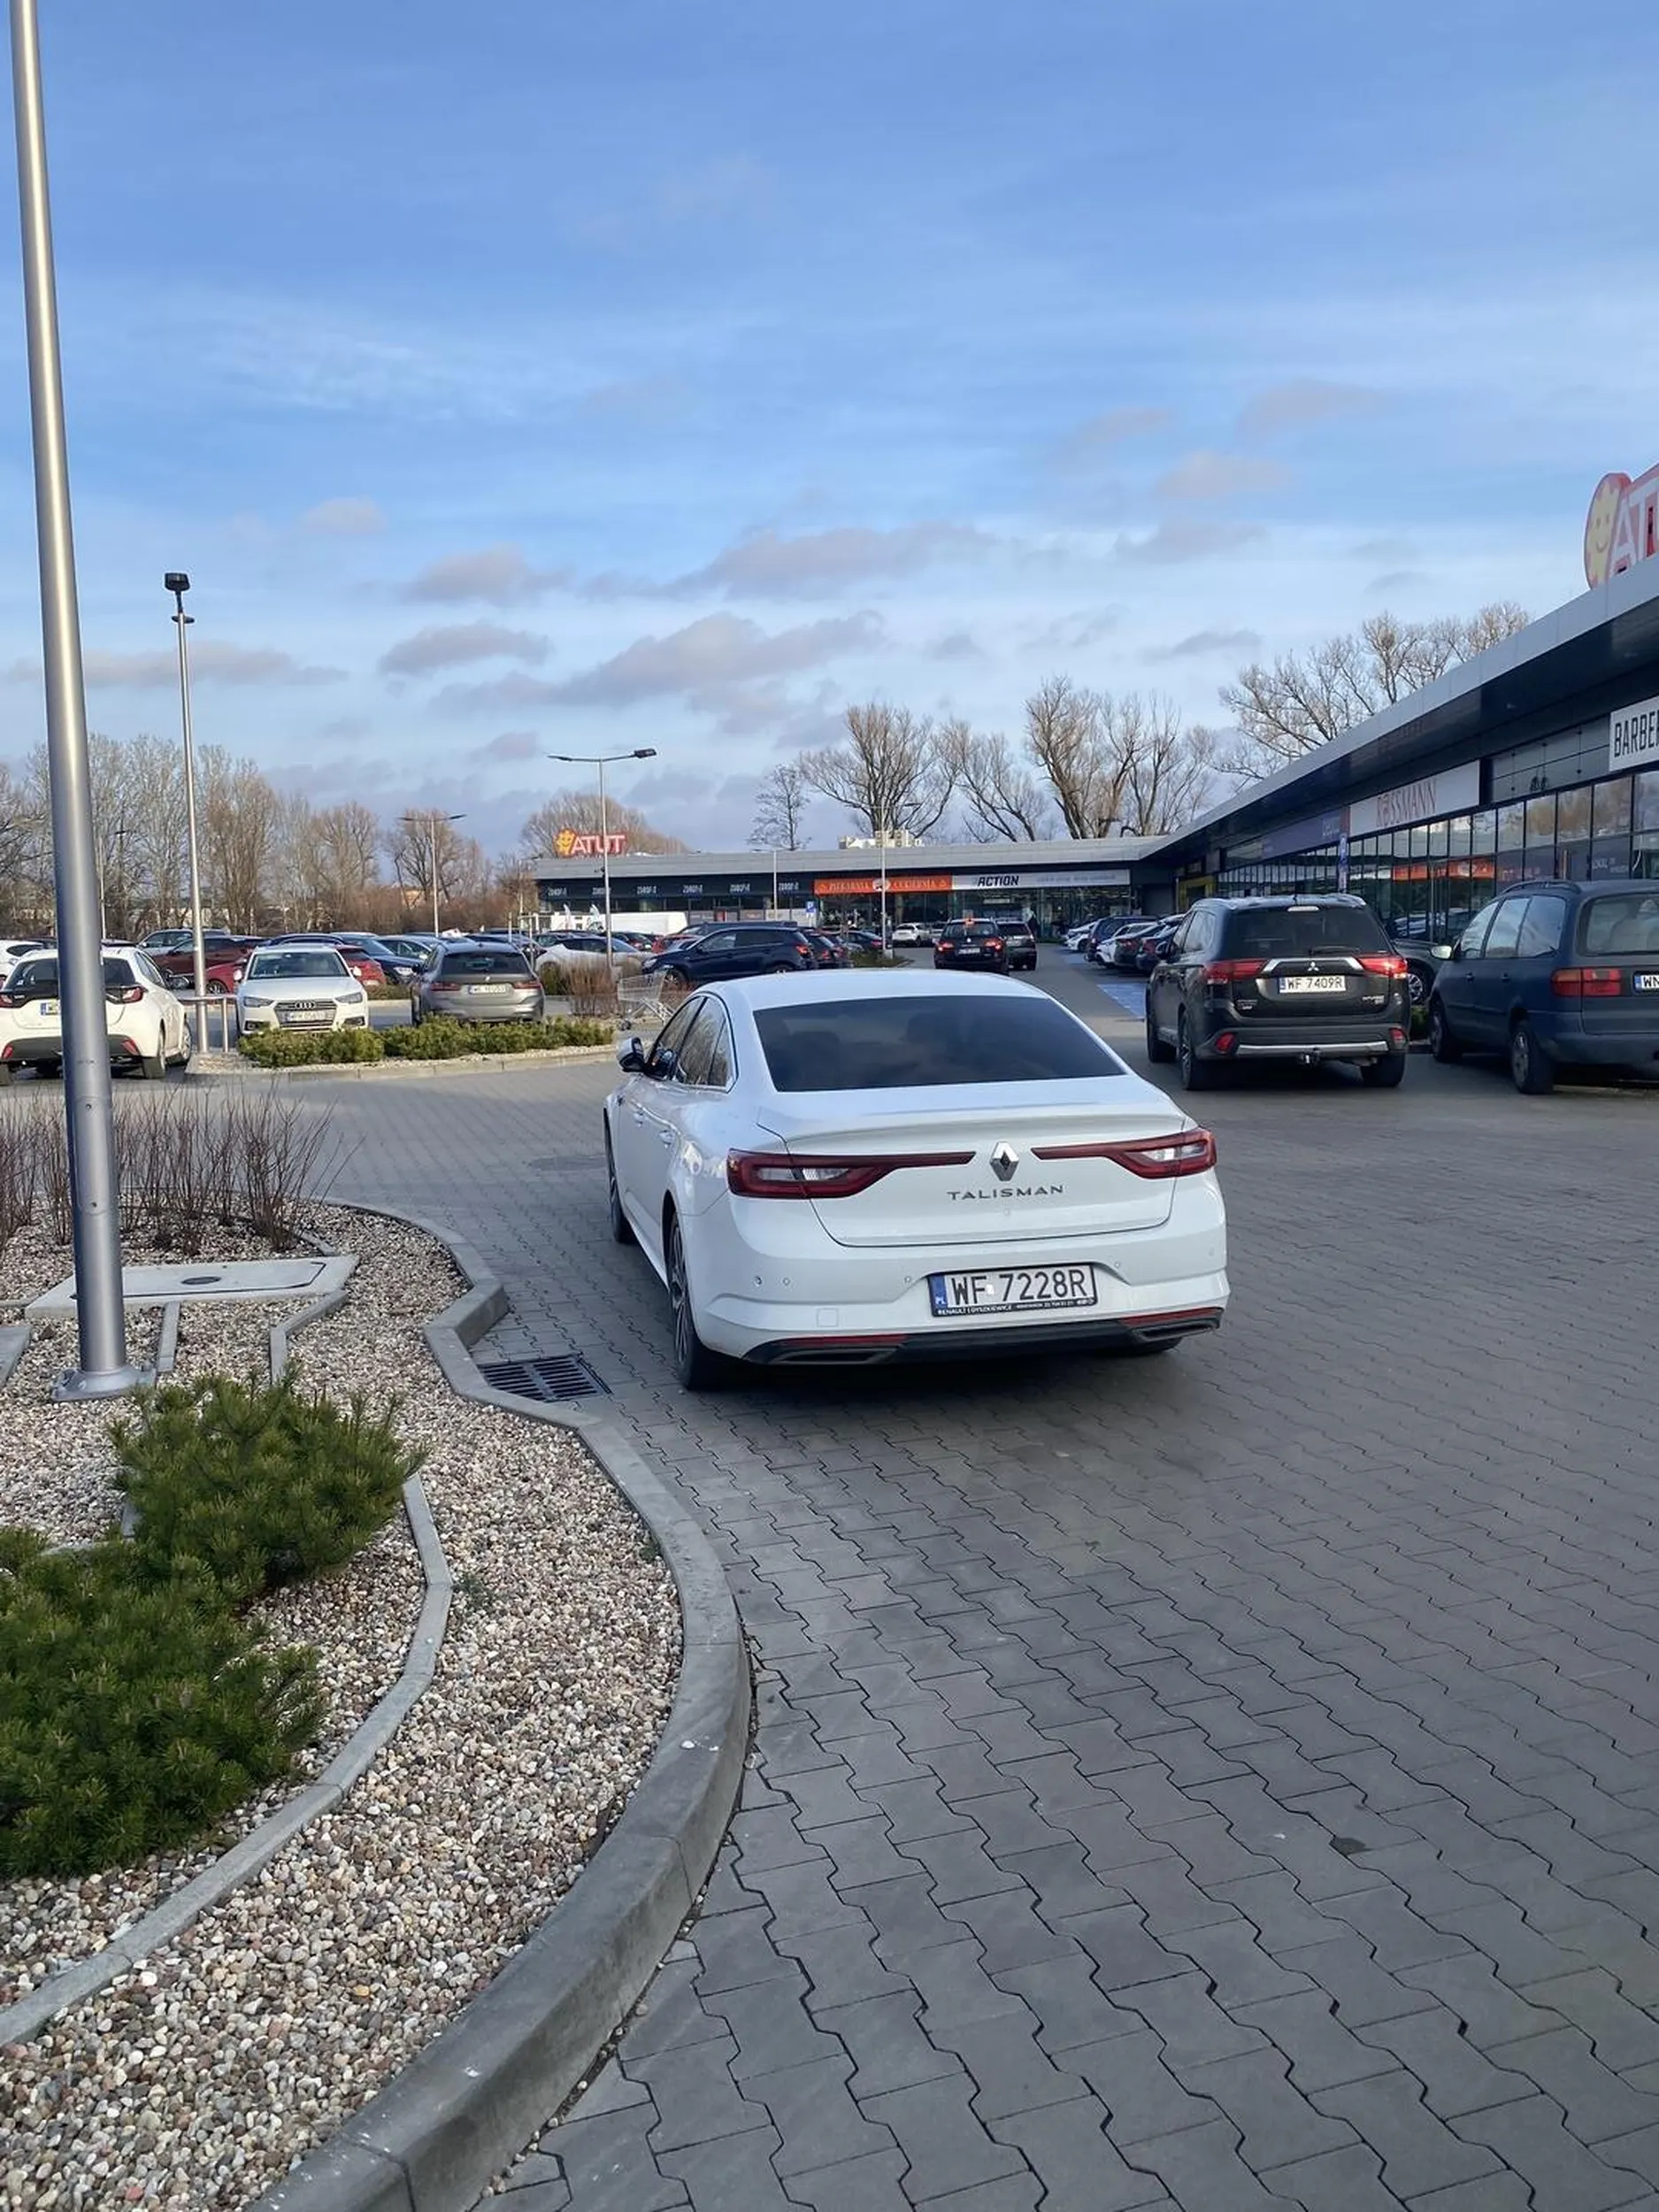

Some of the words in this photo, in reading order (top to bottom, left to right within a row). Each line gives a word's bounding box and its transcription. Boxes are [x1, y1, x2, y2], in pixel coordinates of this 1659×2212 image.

[1609, 475, 1659, 577] AT
[1376, 777, 1438, 828] ROSSMANN
[572, 834, 626, 854] ATUT
[977, 875, 1019, 887] ACTION
[1287, 977, 1302, 990] WF
[1306, 976, 1343, 989] 7409R
[947, 1185, 1063, 1201] TALISMAN
[951, 1275, 987, 1306] WF
[999, 1269, 1087, 1302] 7228R
